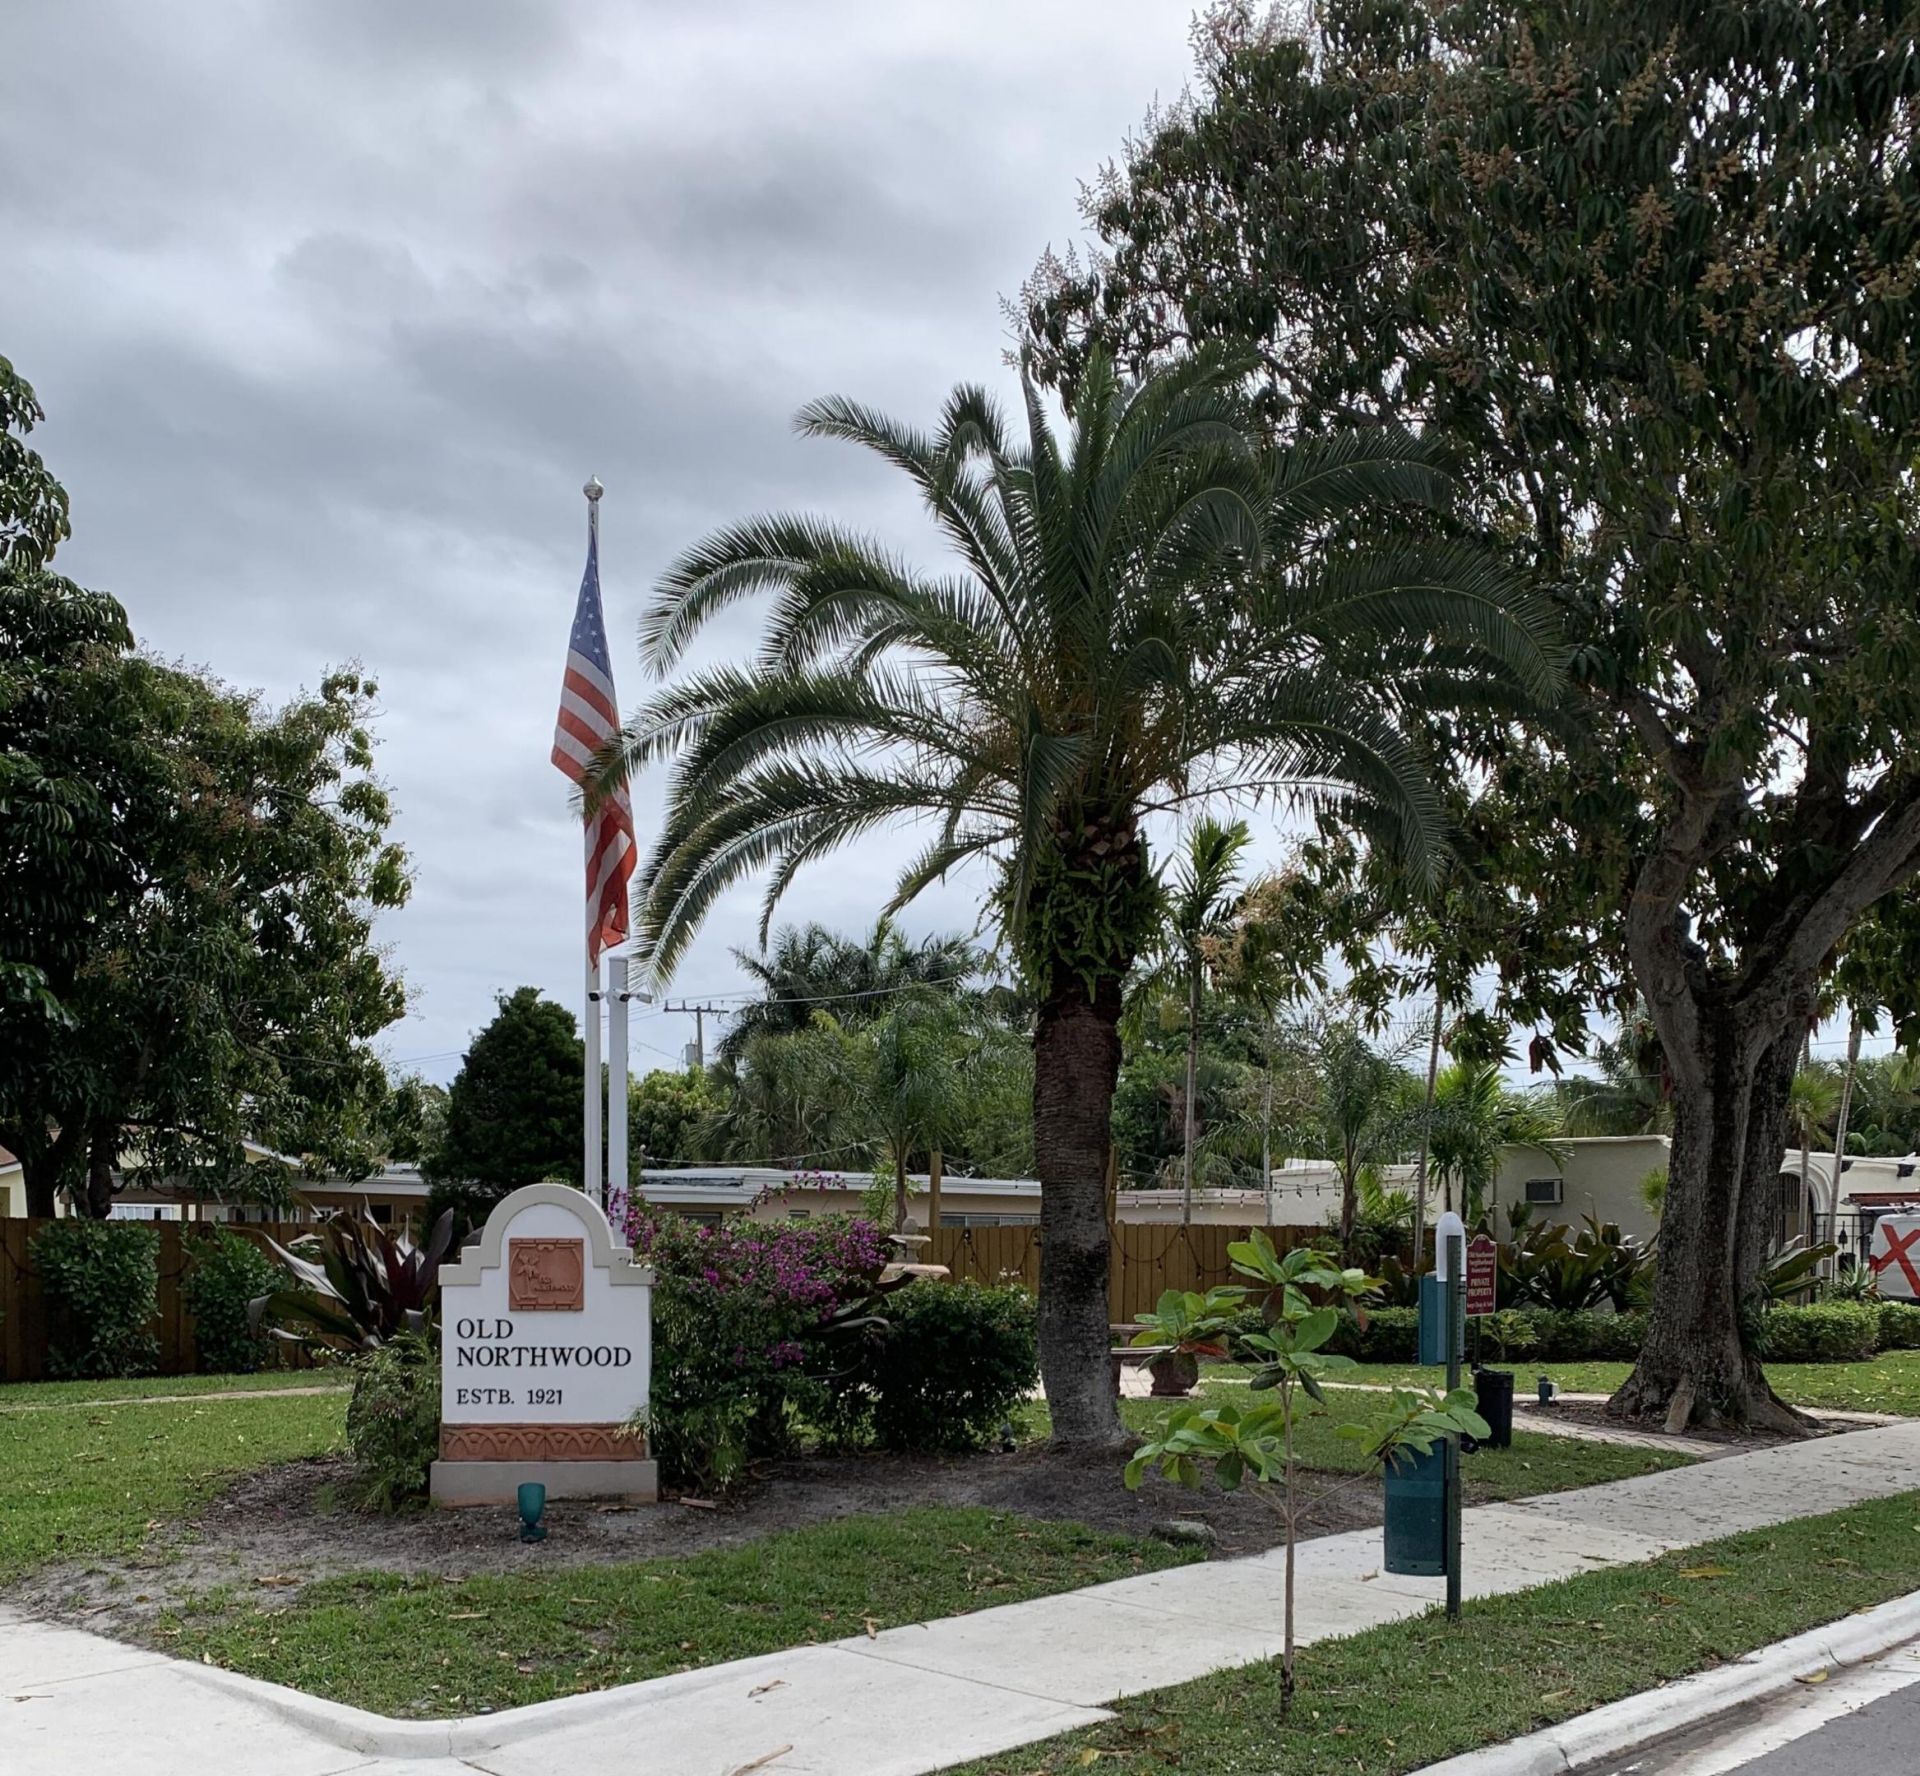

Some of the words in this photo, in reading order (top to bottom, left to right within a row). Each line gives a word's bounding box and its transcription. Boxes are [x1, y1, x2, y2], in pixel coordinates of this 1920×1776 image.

[1471, 1278, 1490, 1286] PRIVATE
[1467, 1287, 1492, 1297] PROPERTY
[456, 1318, 514, 1340] OLD
[456, 1346, 632, 1367] NORTHWOOD
[457, 1388, 515, 1405] ESTB.
[527, 1389, 563, 1405] 1921
